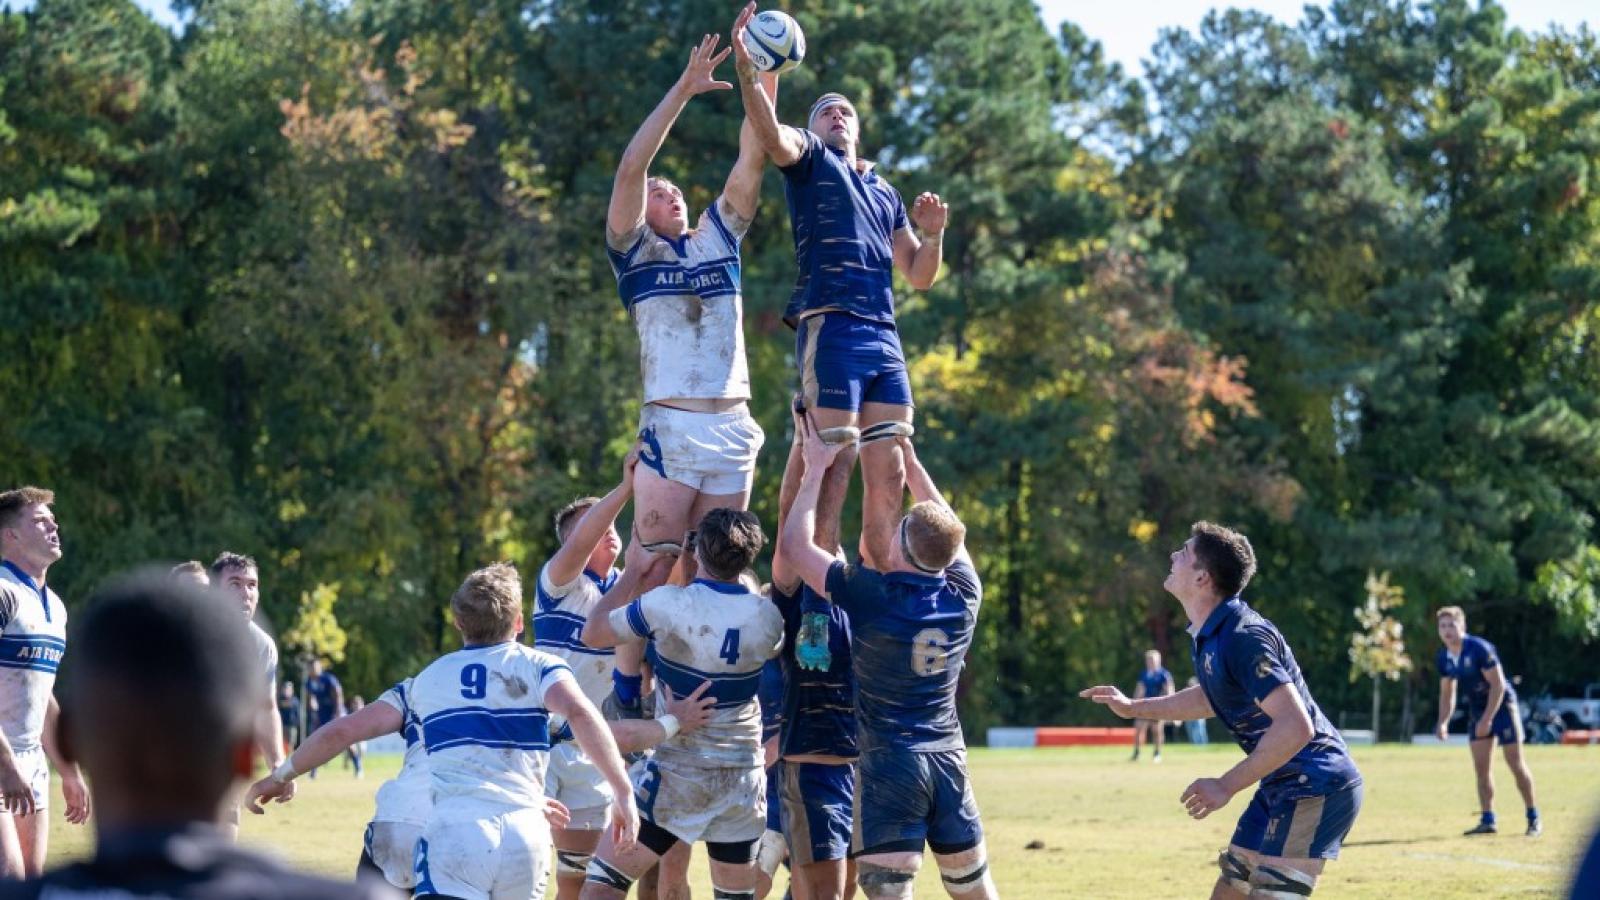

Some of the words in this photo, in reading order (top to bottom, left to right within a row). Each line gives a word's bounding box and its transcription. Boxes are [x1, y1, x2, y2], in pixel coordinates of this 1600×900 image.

[655, 271, 685, 286] AIR
[688, 271, 726, 290] ORC
[17, 646, 43, 659] AIR
[44, 647, 64, 664] FOR
[719, 628, 740, 665] 4
[911, 627, 949, 678] 6
[460, 663, 487, 700] 9
